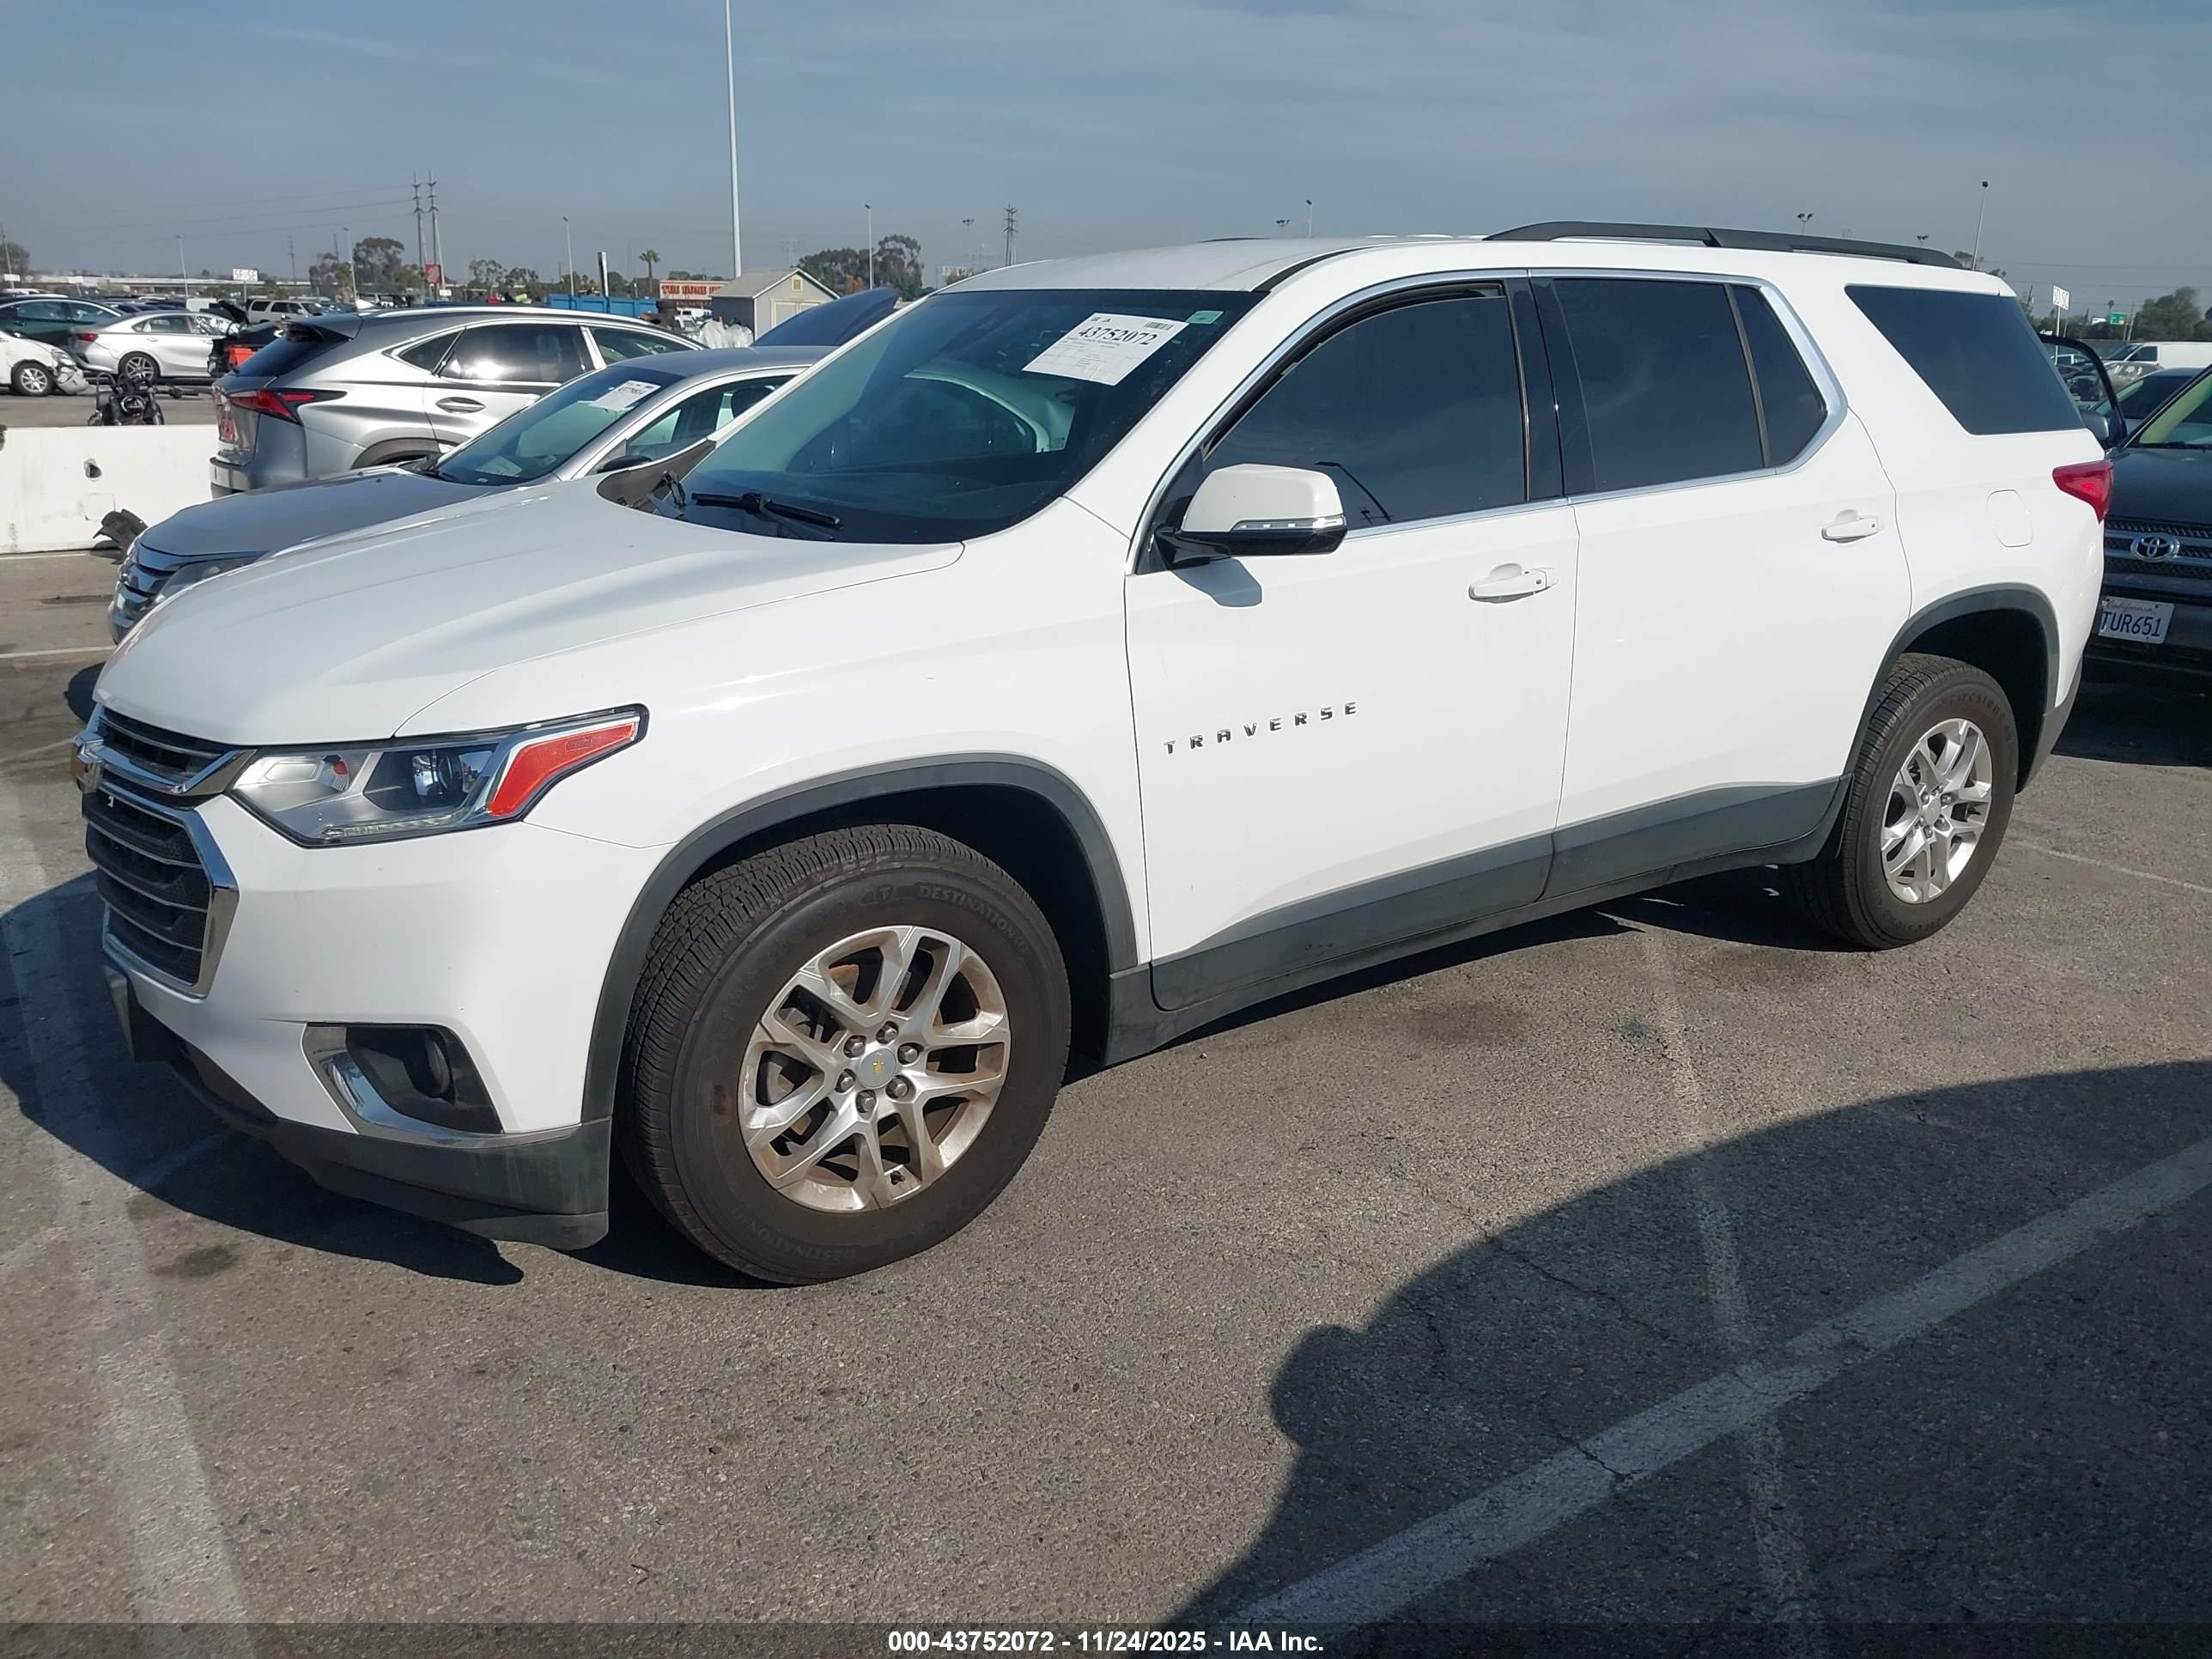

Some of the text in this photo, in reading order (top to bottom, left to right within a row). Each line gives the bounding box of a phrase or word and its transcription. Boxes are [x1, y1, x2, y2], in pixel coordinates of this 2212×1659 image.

[1078, 325, 1158, 345] 43752072
[2100, 611, 2161, 637] TUR651
[1164, 702, 1358, 755] TRAVERSE
[920, 885, 1017, 940] DESTINATION
